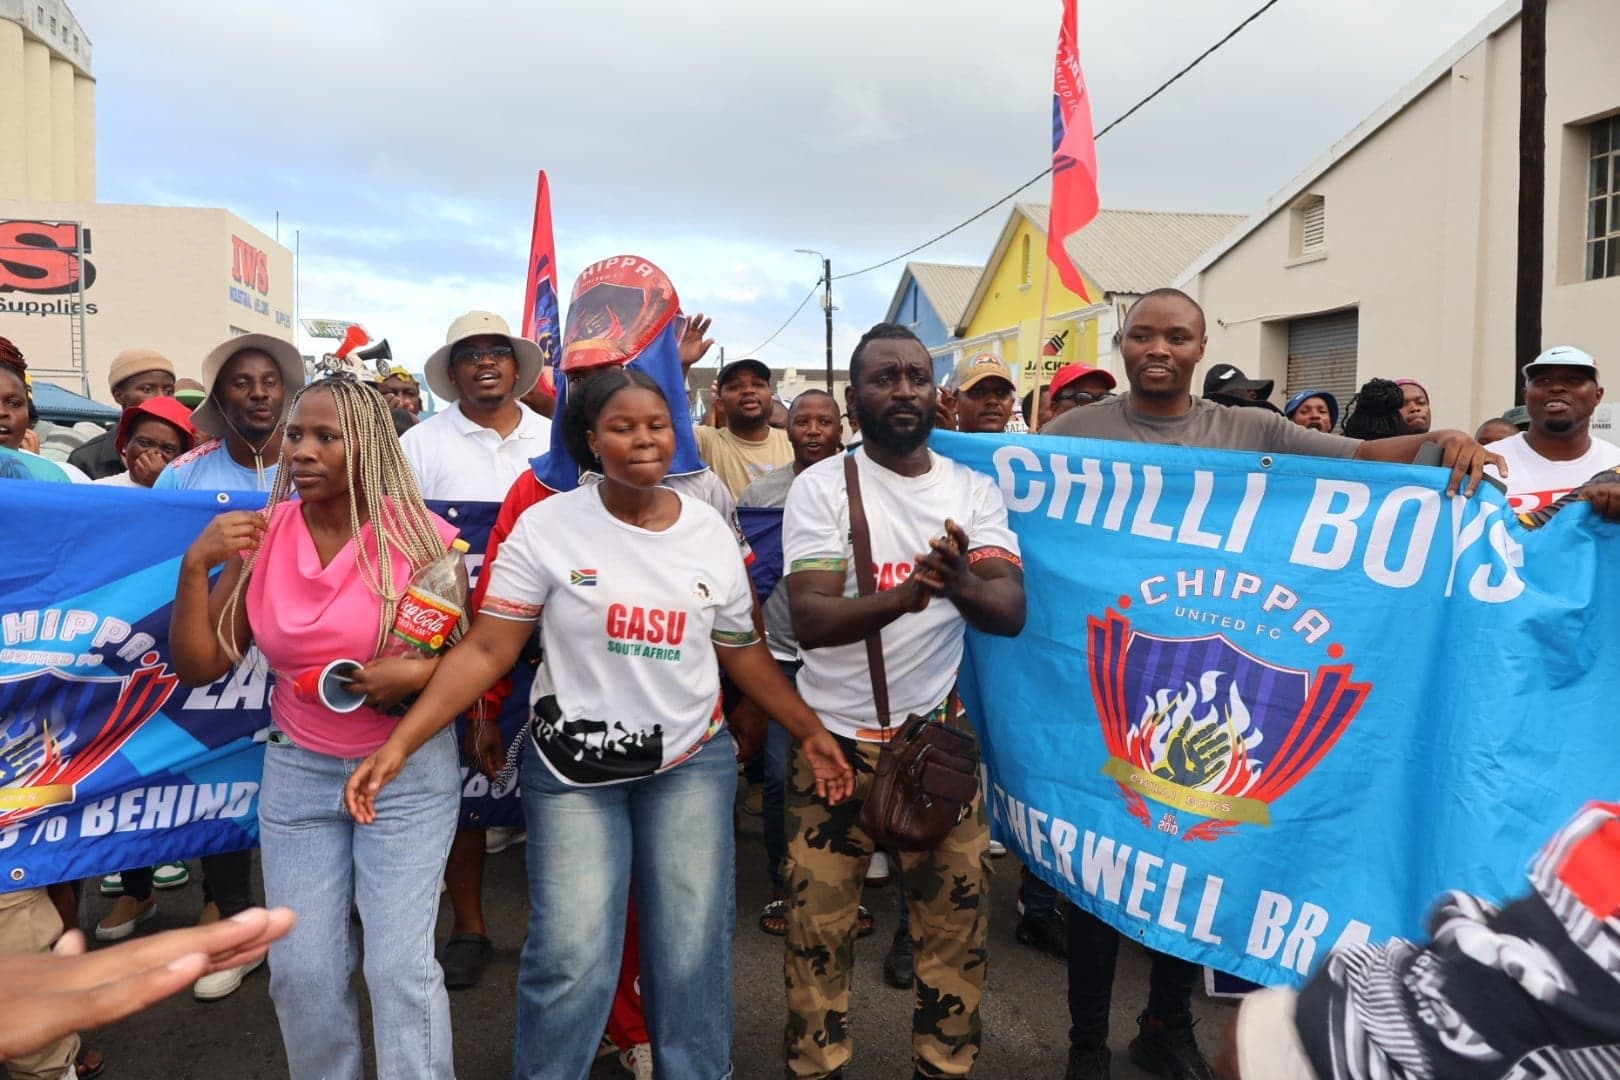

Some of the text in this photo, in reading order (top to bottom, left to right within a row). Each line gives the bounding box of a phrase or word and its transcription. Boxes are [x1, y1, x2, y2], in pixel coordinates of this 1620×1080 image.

[232, 234, 269, 296] IWS
[582, 257, 654, 280] HIPPA
[993, 445, 1525, 603] CHILLI BOYS
[607, 603, 686, 645] GASU
[1140, 568, 1331, 644] CHIPPA
[1175, 606, 1281, 640] UNITED FC
[2, 609, 156, 662] HIPPA
[607, 640, 681, 661] SOUTH AFRICA
[80, 783, 260, 838] BEHIND
[1186, 794, 1231, 813] BOYS
[1157, 820, 1178, 836] 2010
[980, 763, 1224, 945] THERWELL
